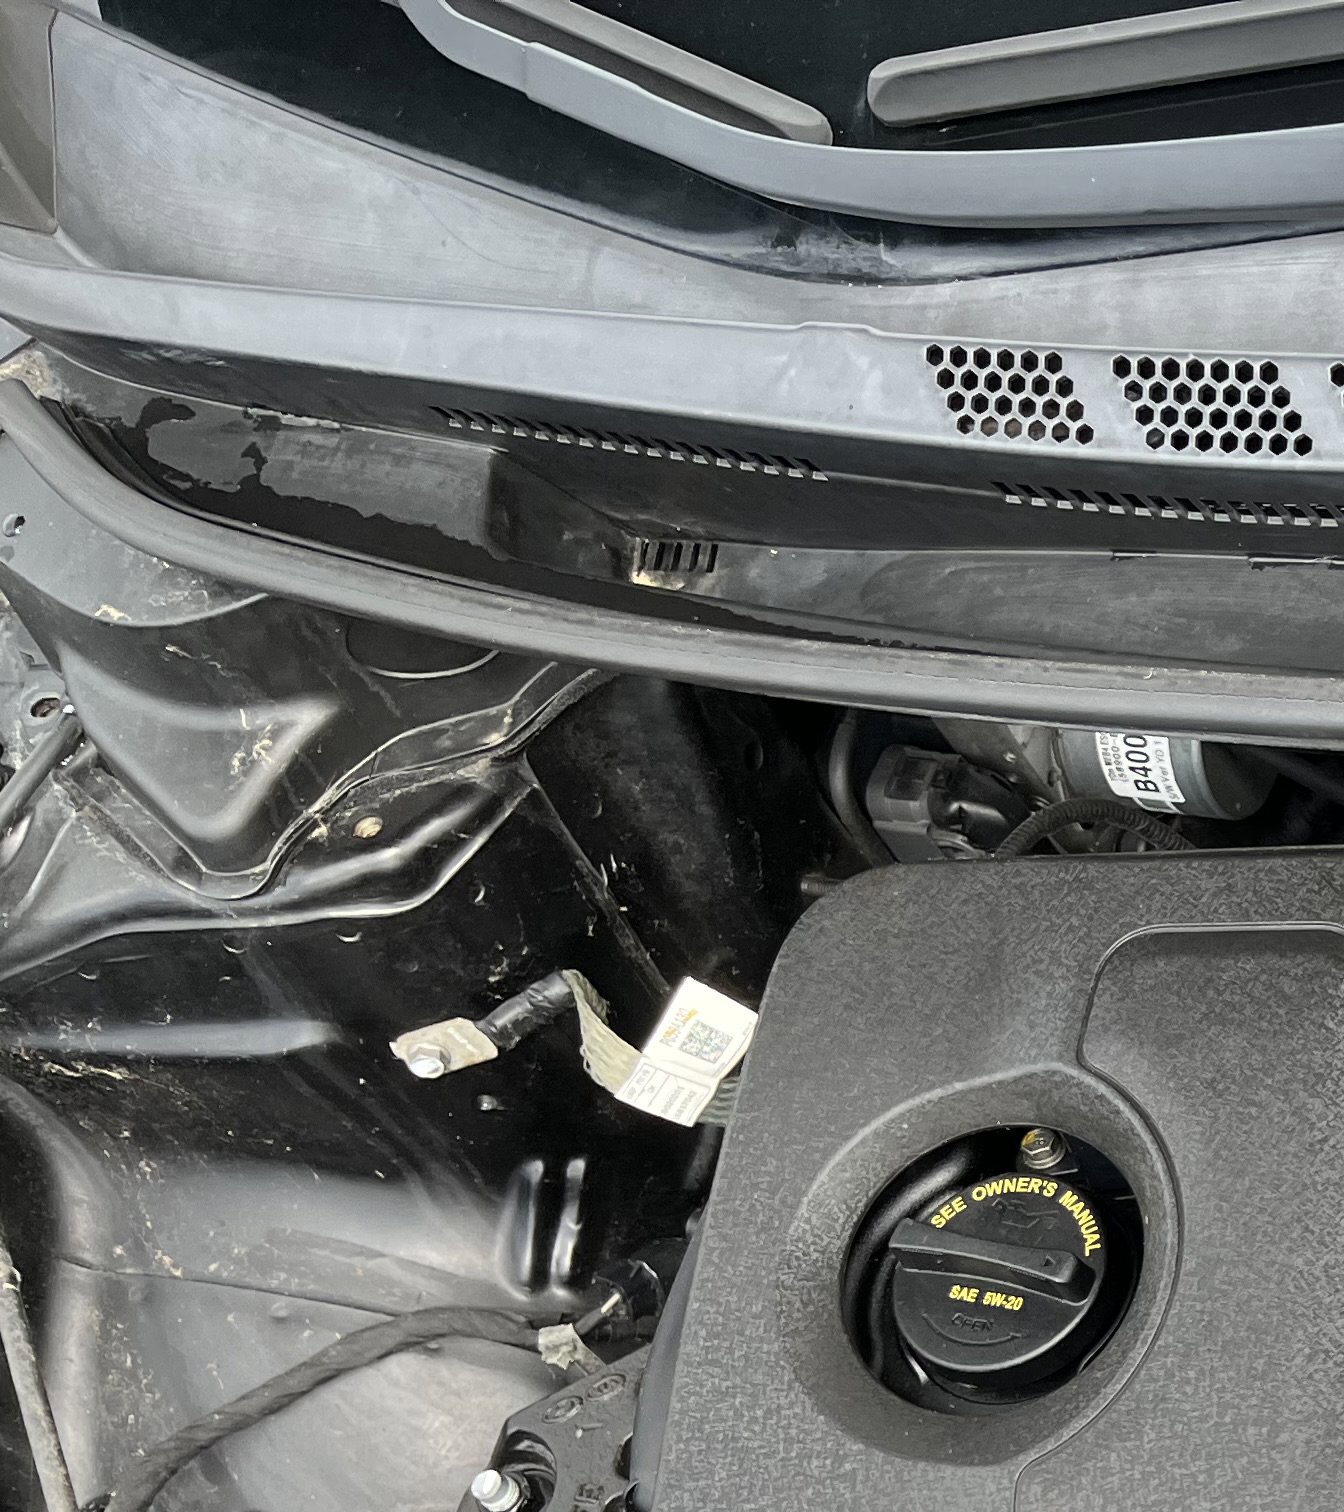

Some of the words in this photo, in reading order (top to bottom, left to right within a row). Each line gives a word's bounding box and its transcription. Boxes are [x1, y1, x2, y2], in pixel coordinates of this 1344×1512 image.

[930, 1196, 968, 1229] SEE
[971, 1177, 1059, 1202] OWNER'S
[1058, 1190, 1102, 1257] MANUAL
[949, 1284, 980, 1303] SAE
[982, 1291, 1025, 1311] 5W-20
[951, 1312, 995, 1332] OPEN
